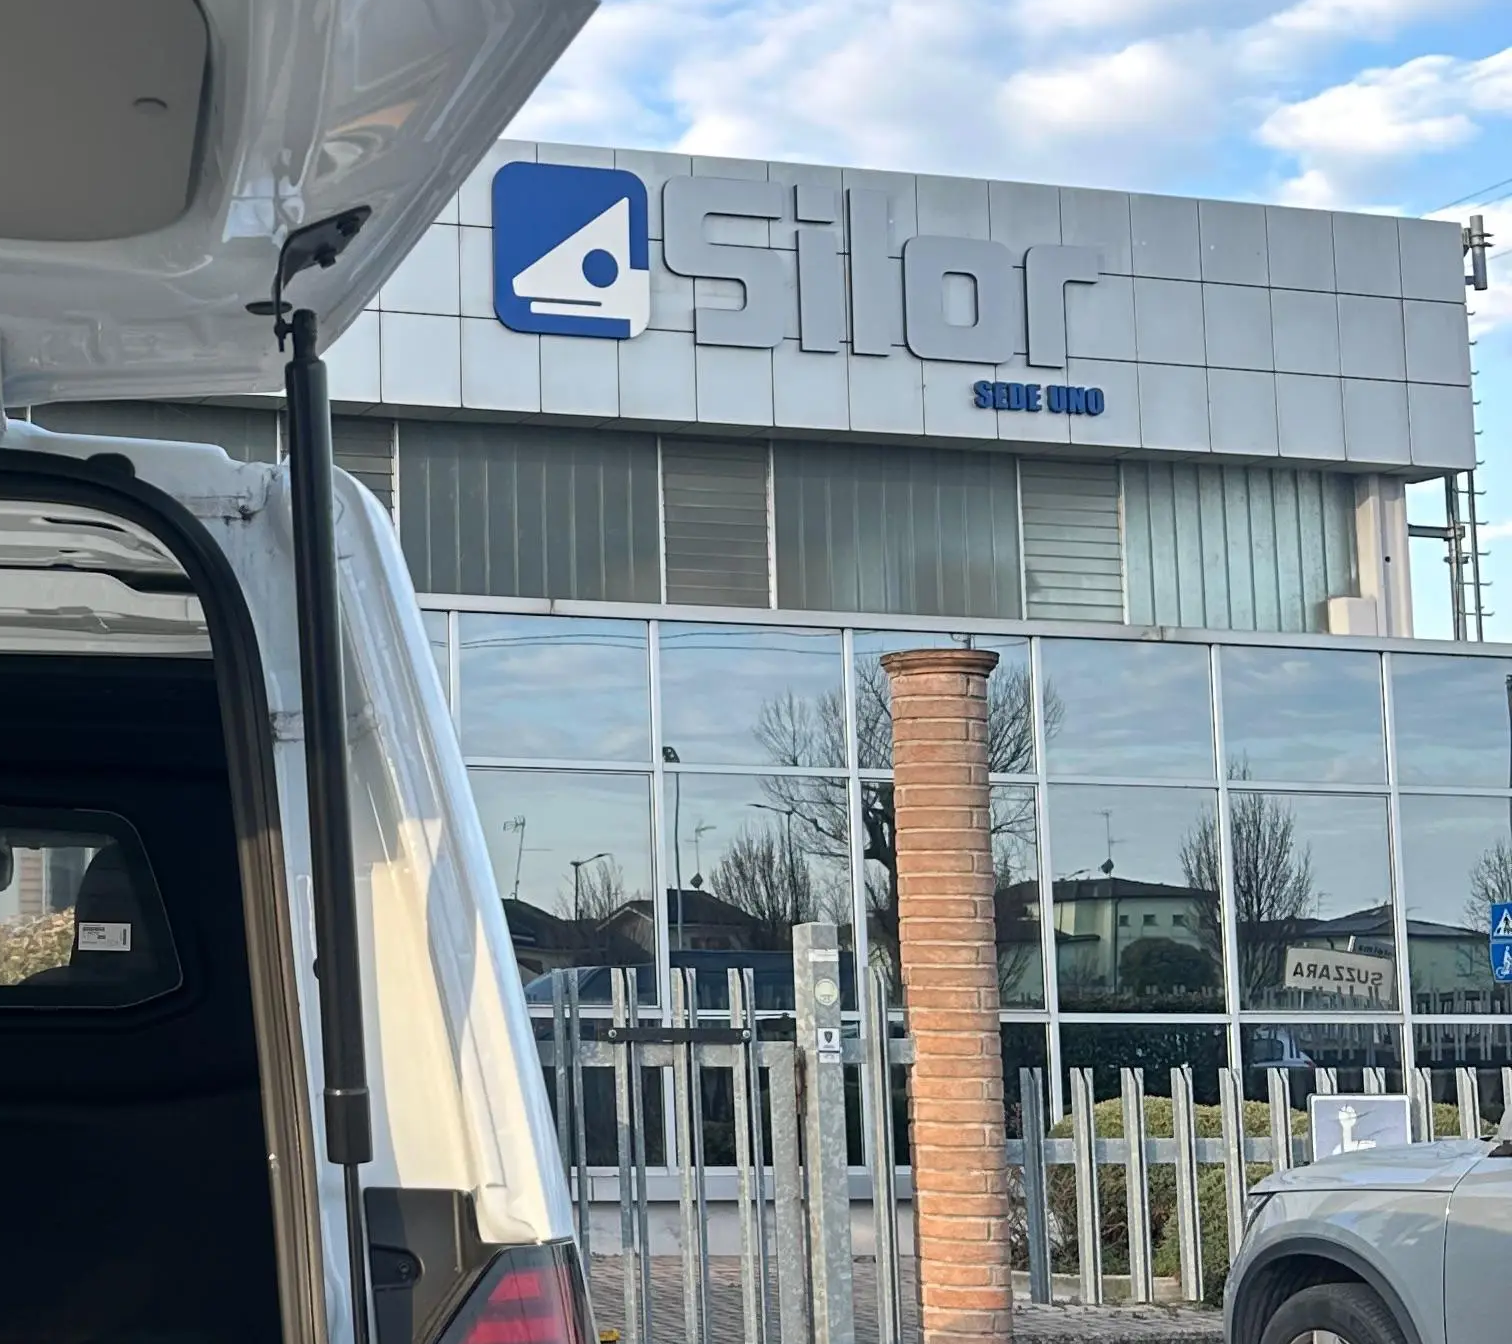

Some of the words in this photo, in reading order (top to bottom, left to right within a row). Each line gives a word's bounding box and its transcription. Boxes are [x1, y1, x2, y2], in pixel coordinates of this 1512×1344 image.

[662, 175, 1099, 368] Silor
[973, 380, 1042, 412] SEDE
[1047, 384, 1105, 416] UNO
